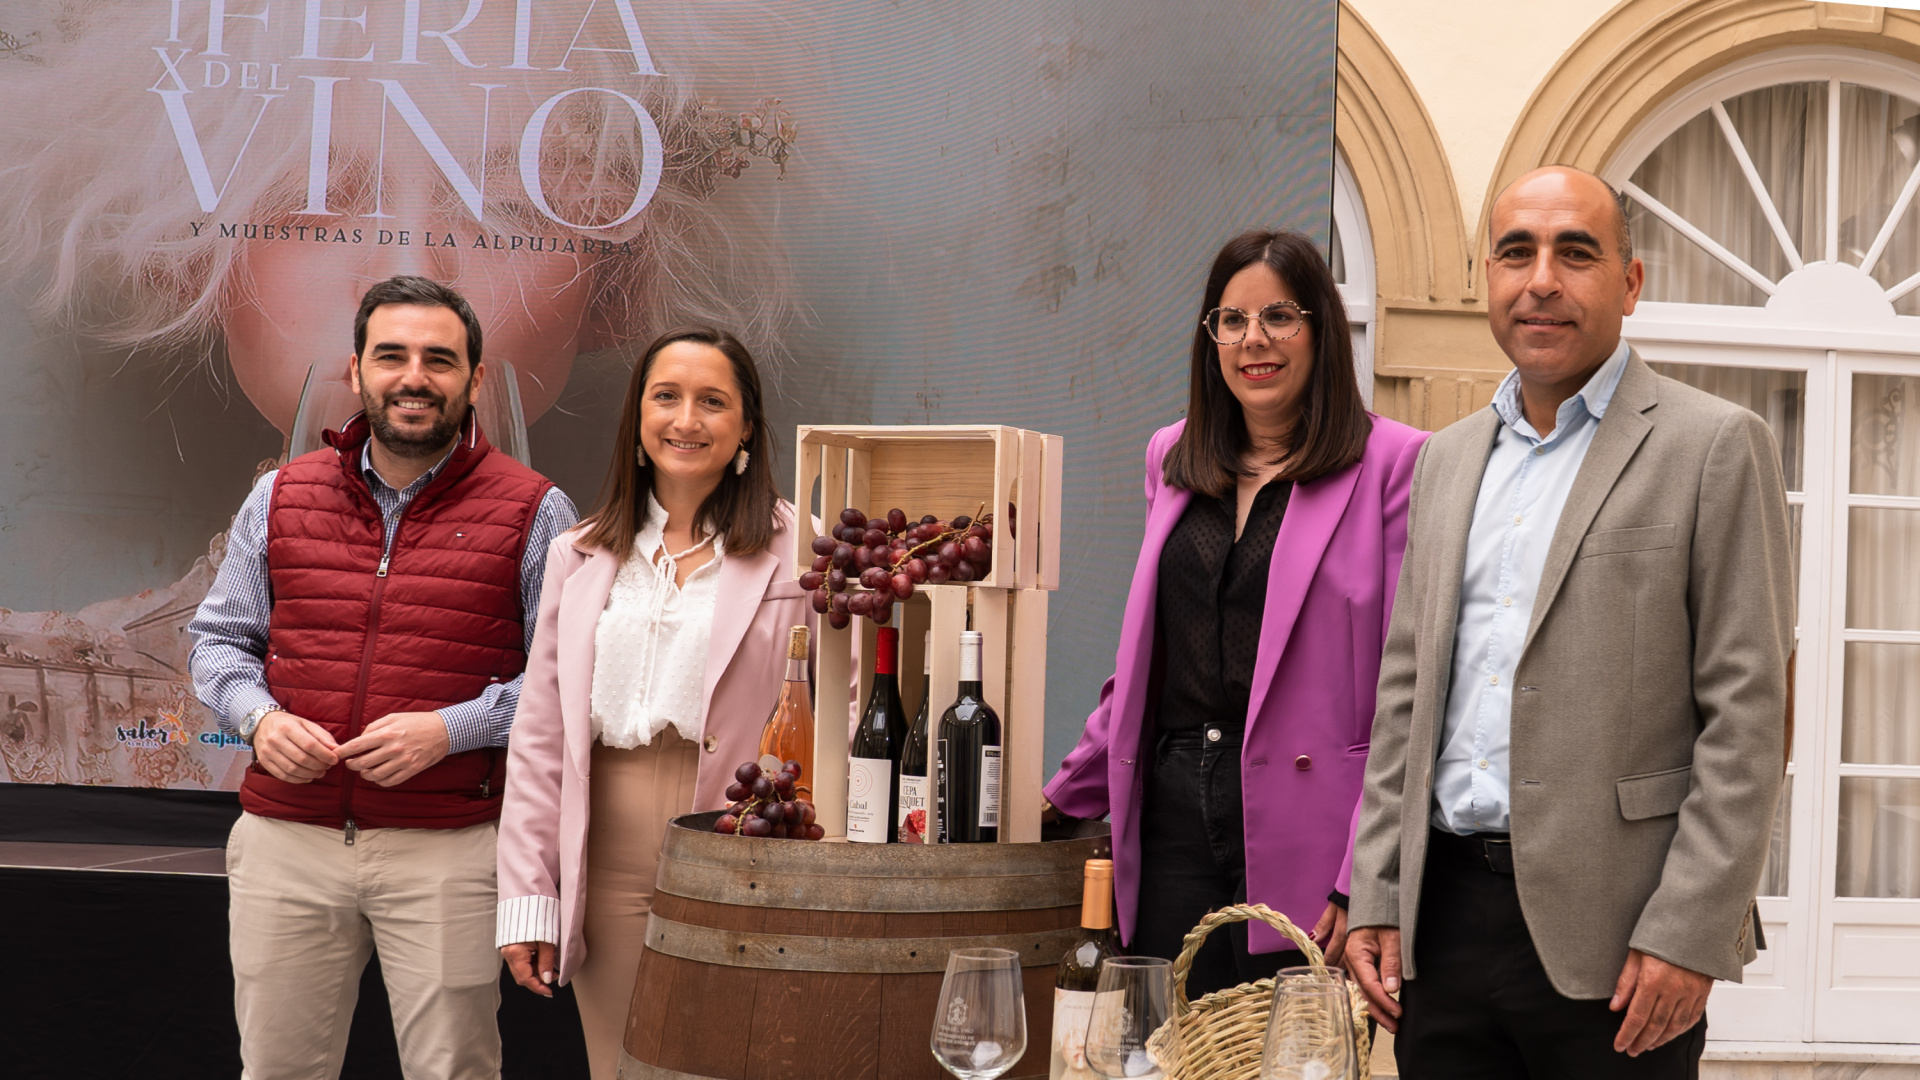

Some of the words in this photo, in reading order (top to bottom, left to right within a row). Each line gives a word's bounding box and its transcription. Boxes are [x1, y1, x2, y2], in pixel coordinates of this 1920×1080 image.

[198, 0, 669, 76] FERIA
[146, 47, 193, 93] X
[202, 60, 289, 91] DEL
[147, 75, 664, 229] VINO
[190, 222, 204, 237] Y
[219, 223, 363, 243] MUESTRAS
[378, 229, 410, 246] DE
[425, 231, 457, 247] LA
[472, 234, 634, 256] ALPUJARRA
[116, 720, 189, 745] sabores
